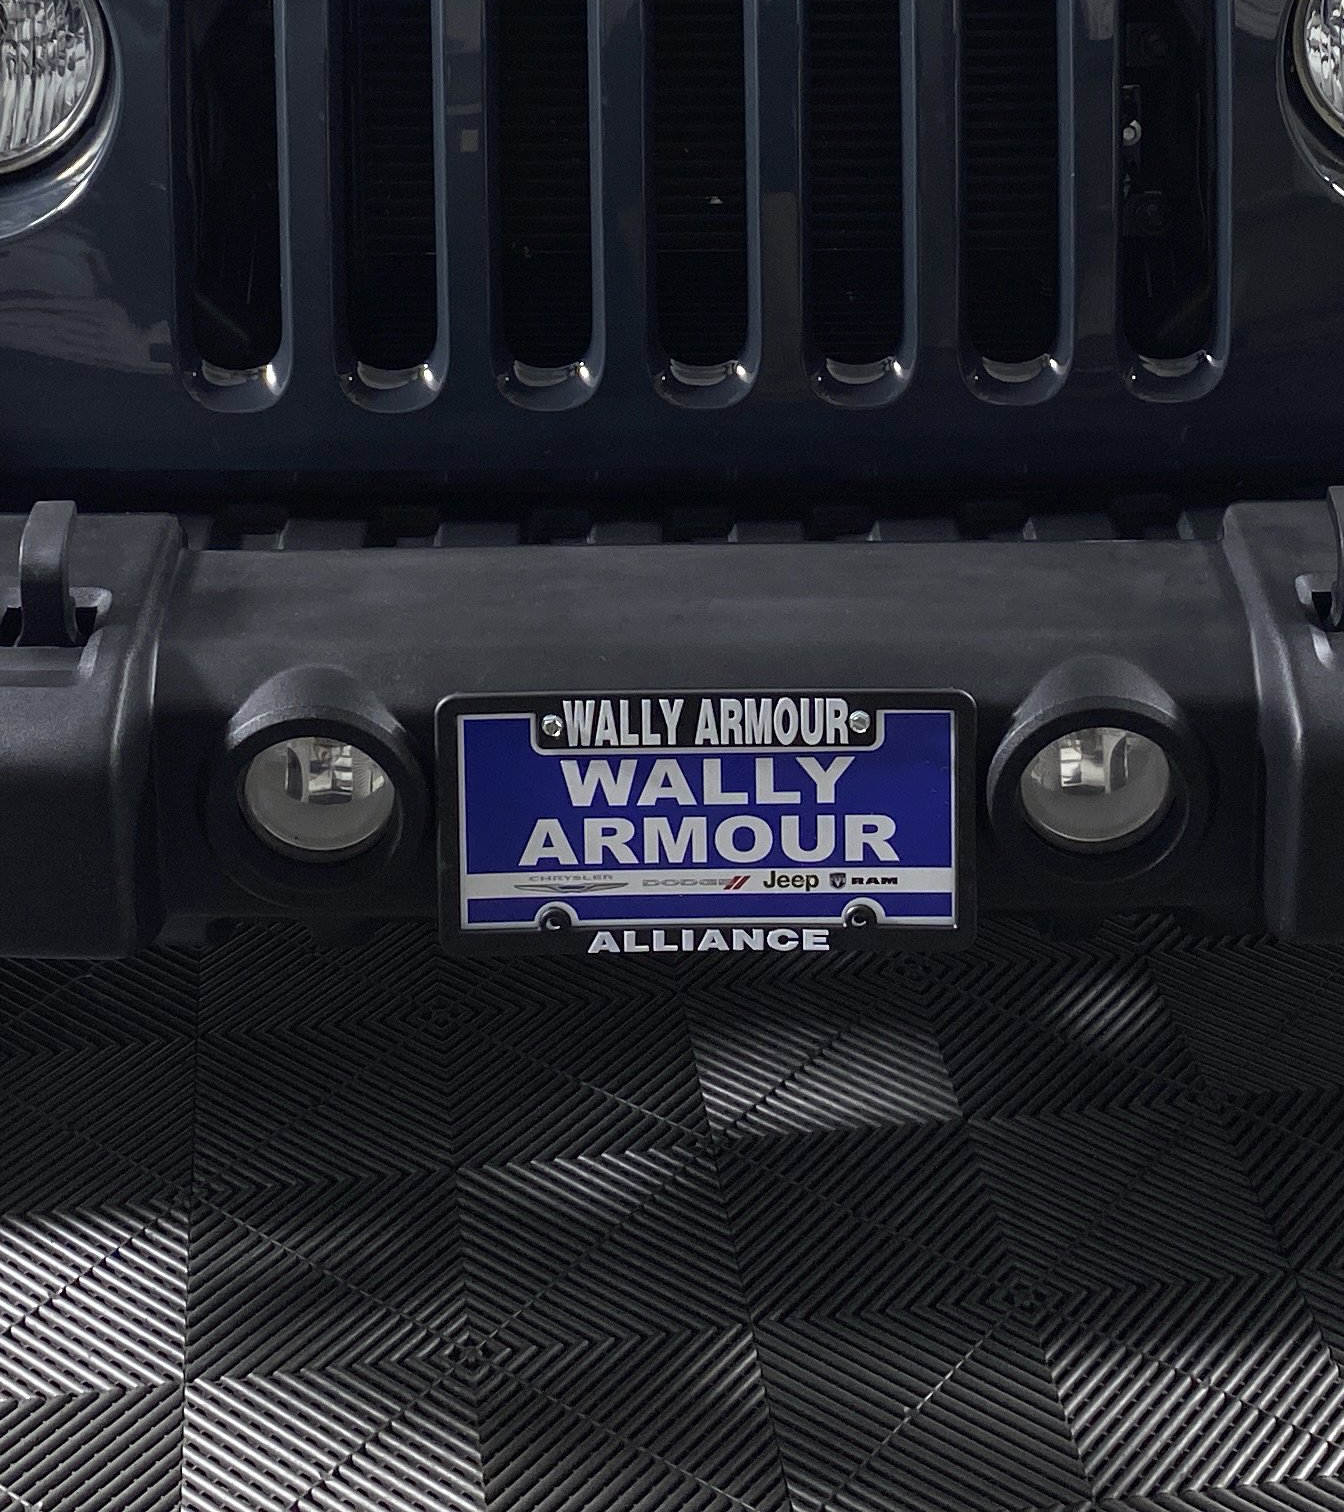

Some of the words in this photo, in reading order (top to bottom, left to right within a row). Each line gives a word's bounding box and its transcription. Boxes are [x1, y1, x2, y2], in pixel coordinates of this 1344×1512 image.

[562, 697, 684, 746] WALLY
[695, 697, 850, 745] ARMOUR
[560, 756, 856, 807] WALLY
[518, 814, 901, 866] ARMOUR
[528, 873, 613, 882] CHRYSLER
[763, 870, 819, 890] Jeep
[851, 876, 899, 886] RAM
[587, 928, 830, 954] ALLIANCE
